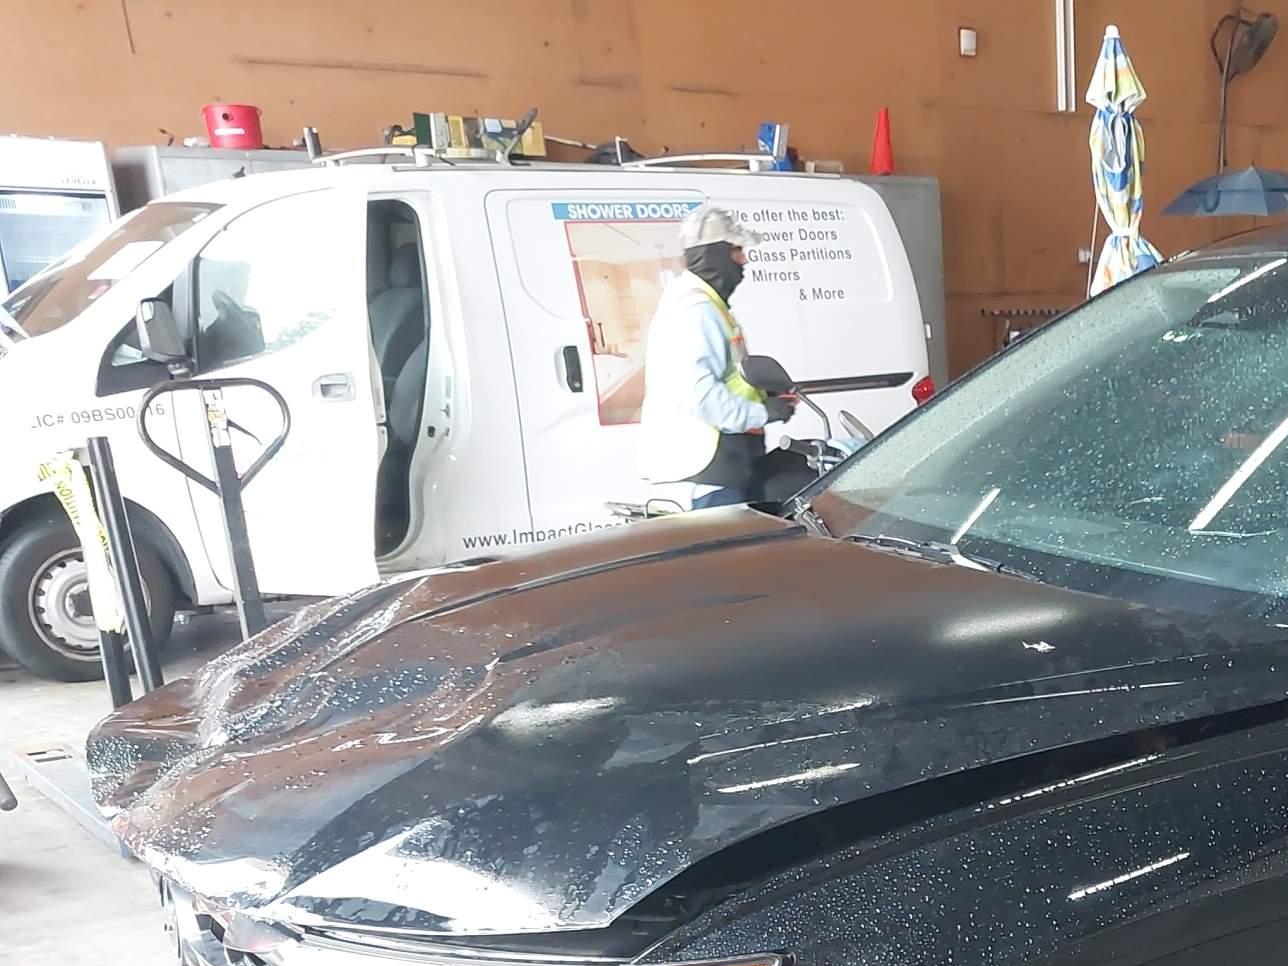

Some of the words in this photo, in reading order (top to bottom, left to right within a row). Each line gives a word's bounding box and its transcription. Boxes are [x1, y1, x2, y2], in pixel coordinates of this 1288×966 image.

[567, 204, 633, 219] SHOWER
[637, 203, 690, 218] DOORS
[753, 209, 783, 222] offer
[788, 209, 808, 221] the
[812, 208, 845, 221] best:
[798, 228, 838, 241] Doors
[748, 249, 786, 262] Glass
[790, 247, 852, 261] Partitions
[751, 269, 801, 282] Mirrors
[799, 288, 808, 301] &
[812, 287, 845, 300] More
[71, 403, 165, 424] 09BS0016
